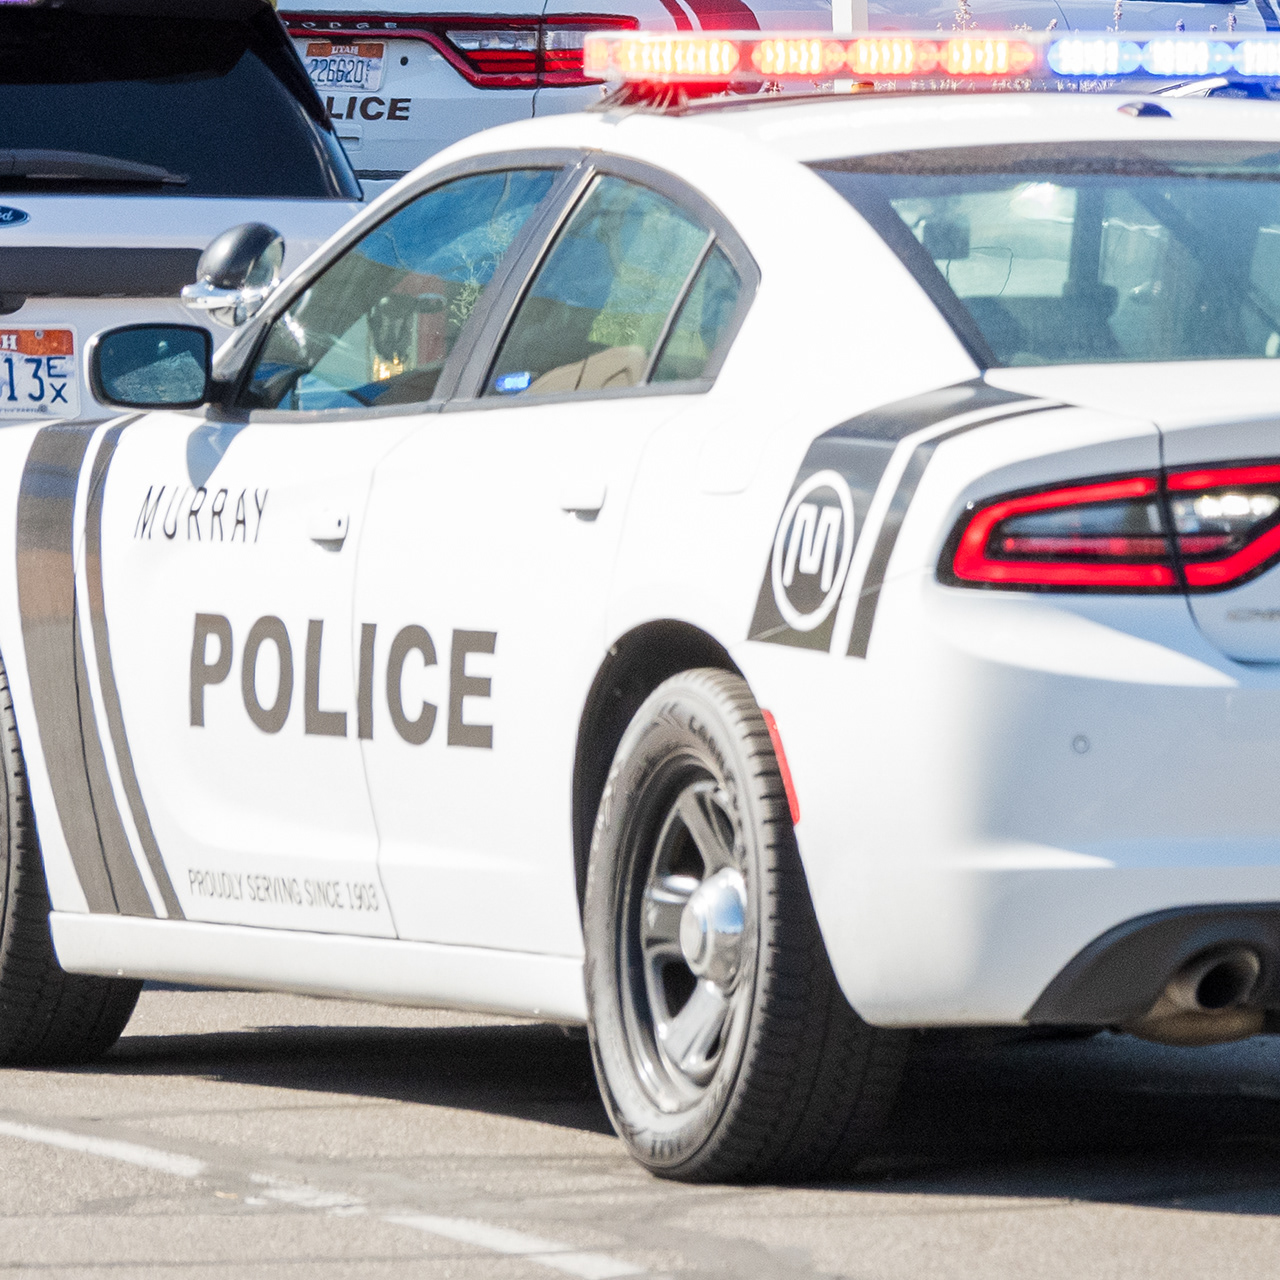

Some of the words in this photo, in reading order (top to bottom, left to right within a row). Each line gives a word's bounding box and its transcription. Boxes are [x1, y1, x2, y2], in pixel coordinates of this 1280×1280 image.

[331, 45, 359, 54] UTAH
[325, 96, 412, 121] LICE
[134, 485, 269, 544] MURRAY
[189, 612, 498, 750] POLICE
[188, 869, 243, 901] PROUDLY
[247, 875, 302, 905] SERVING
[304, 878, 344, 909] SINCE
